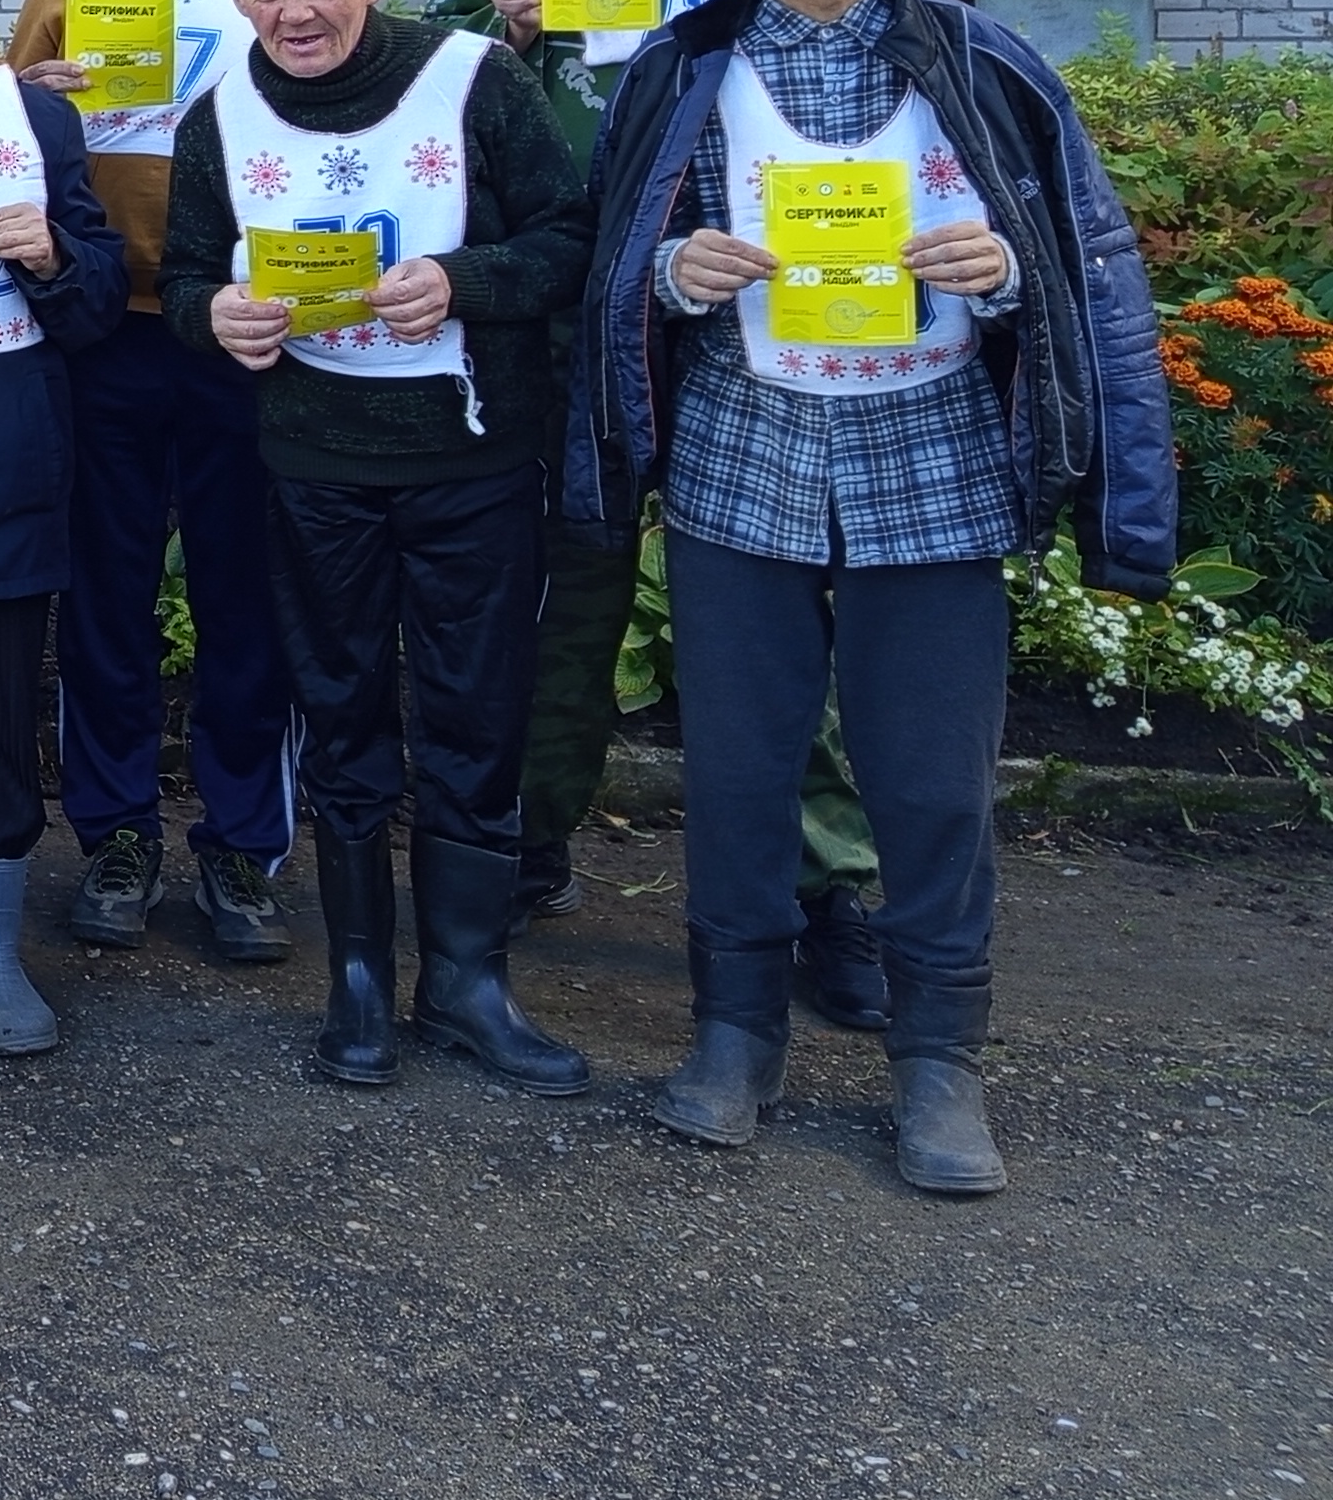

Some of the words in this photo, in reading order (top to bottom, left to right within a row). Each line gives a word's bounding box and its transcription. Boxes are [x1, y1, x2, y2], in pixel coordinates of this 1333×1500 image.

[81, 6, 156, 16] СЕРТИФИКАТ
[77, 52, 105, 69] 20
[136, 52, 162, 66] 25
[785, 207, 887, 220] СЕРТИФИКАТ
[266, 259, 357, 269] СЕРТИФИКАТ
[785, 266, 821, 287] 20
[822, 268, 852, 276] КРОСС
[863, 266, 899, 286] 25
[822, 277, 861, 285] НАЦИИ
[334, 289, 365, 303] 25
